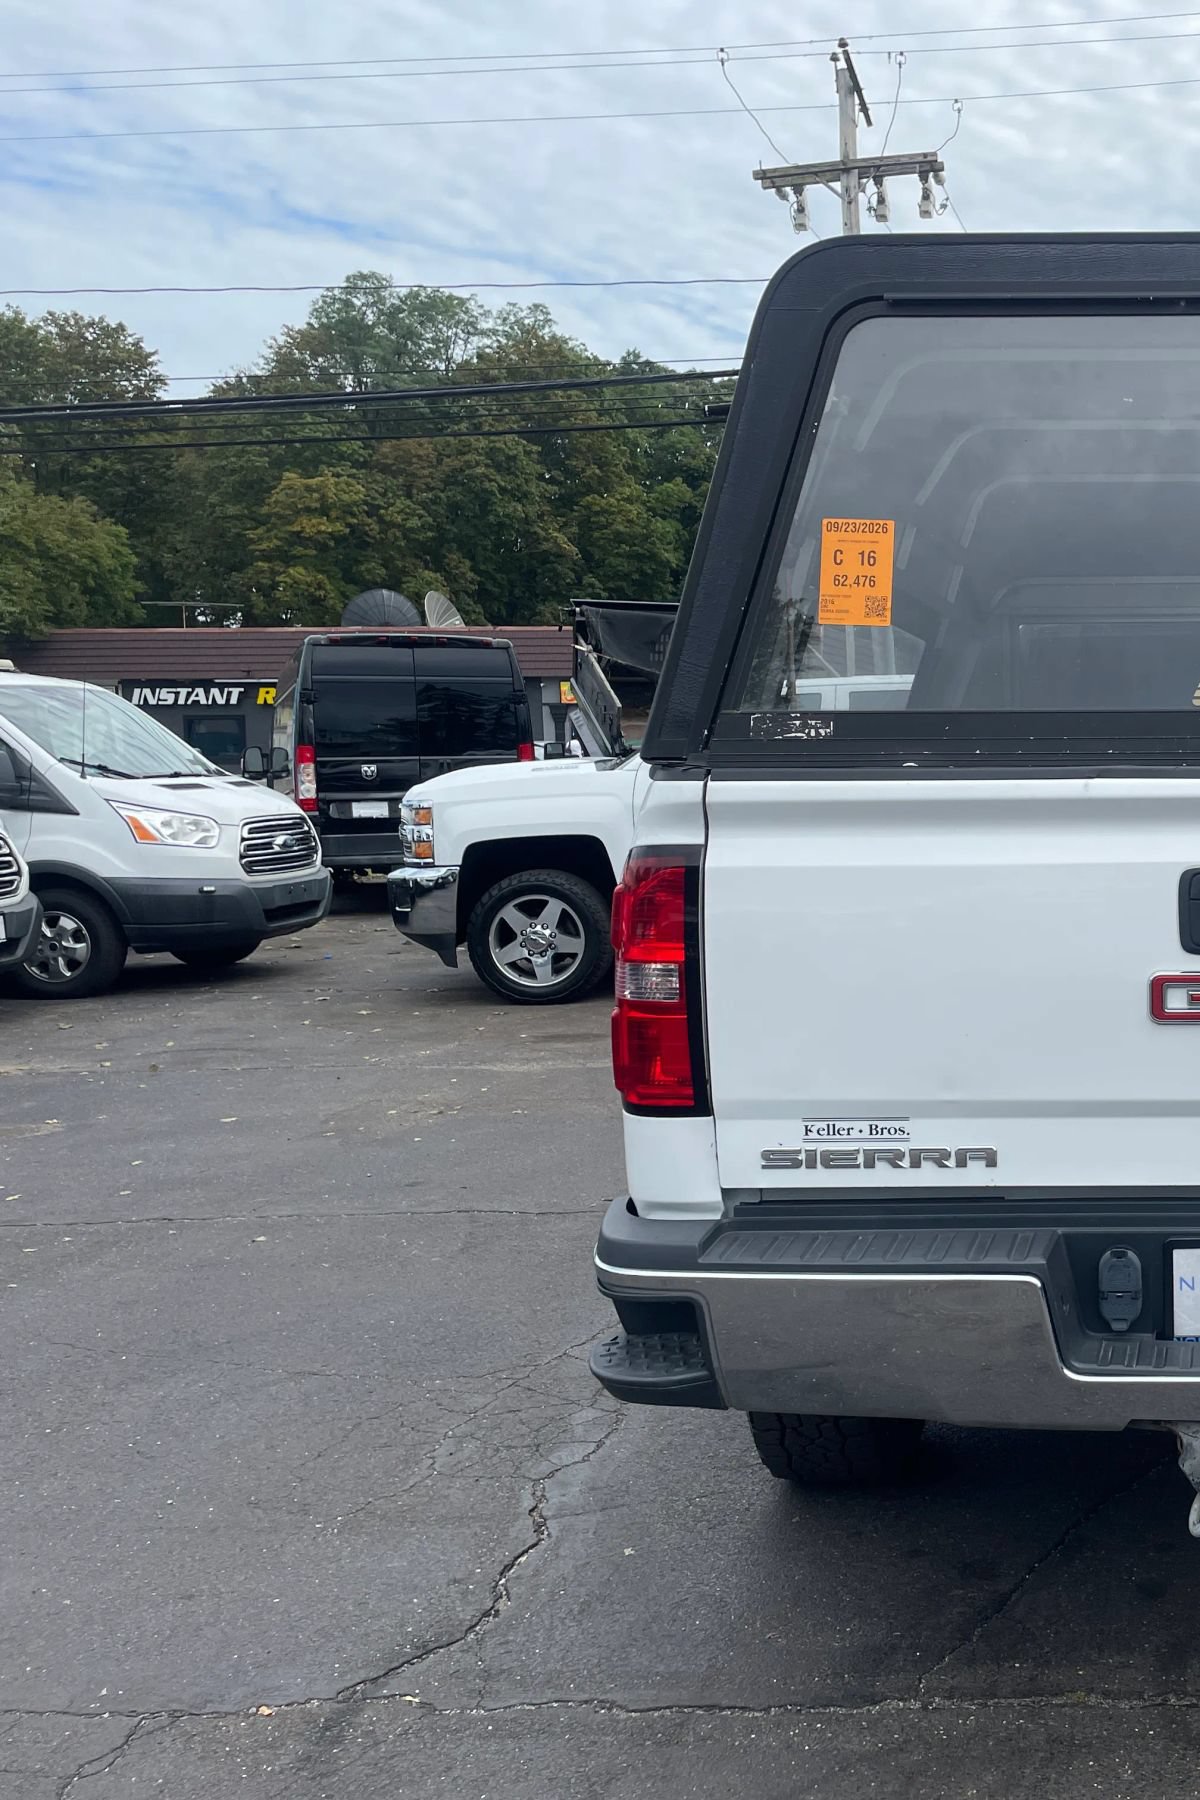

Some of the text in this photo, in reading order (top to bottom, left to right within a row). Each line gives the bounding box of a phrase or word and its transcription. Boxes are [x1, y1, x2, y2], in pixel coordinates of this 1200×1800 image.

[826, 521, 888, 534] 09/23/2026
[833, 549, 877, 567] C 16
[833, 574, 876, 588] 62,476
[132, 687, 244, 705] INSTANT
[804, 1123, 911, 1137] Keller Bros.
[760, 1146, 998, 1169] SIERRA
